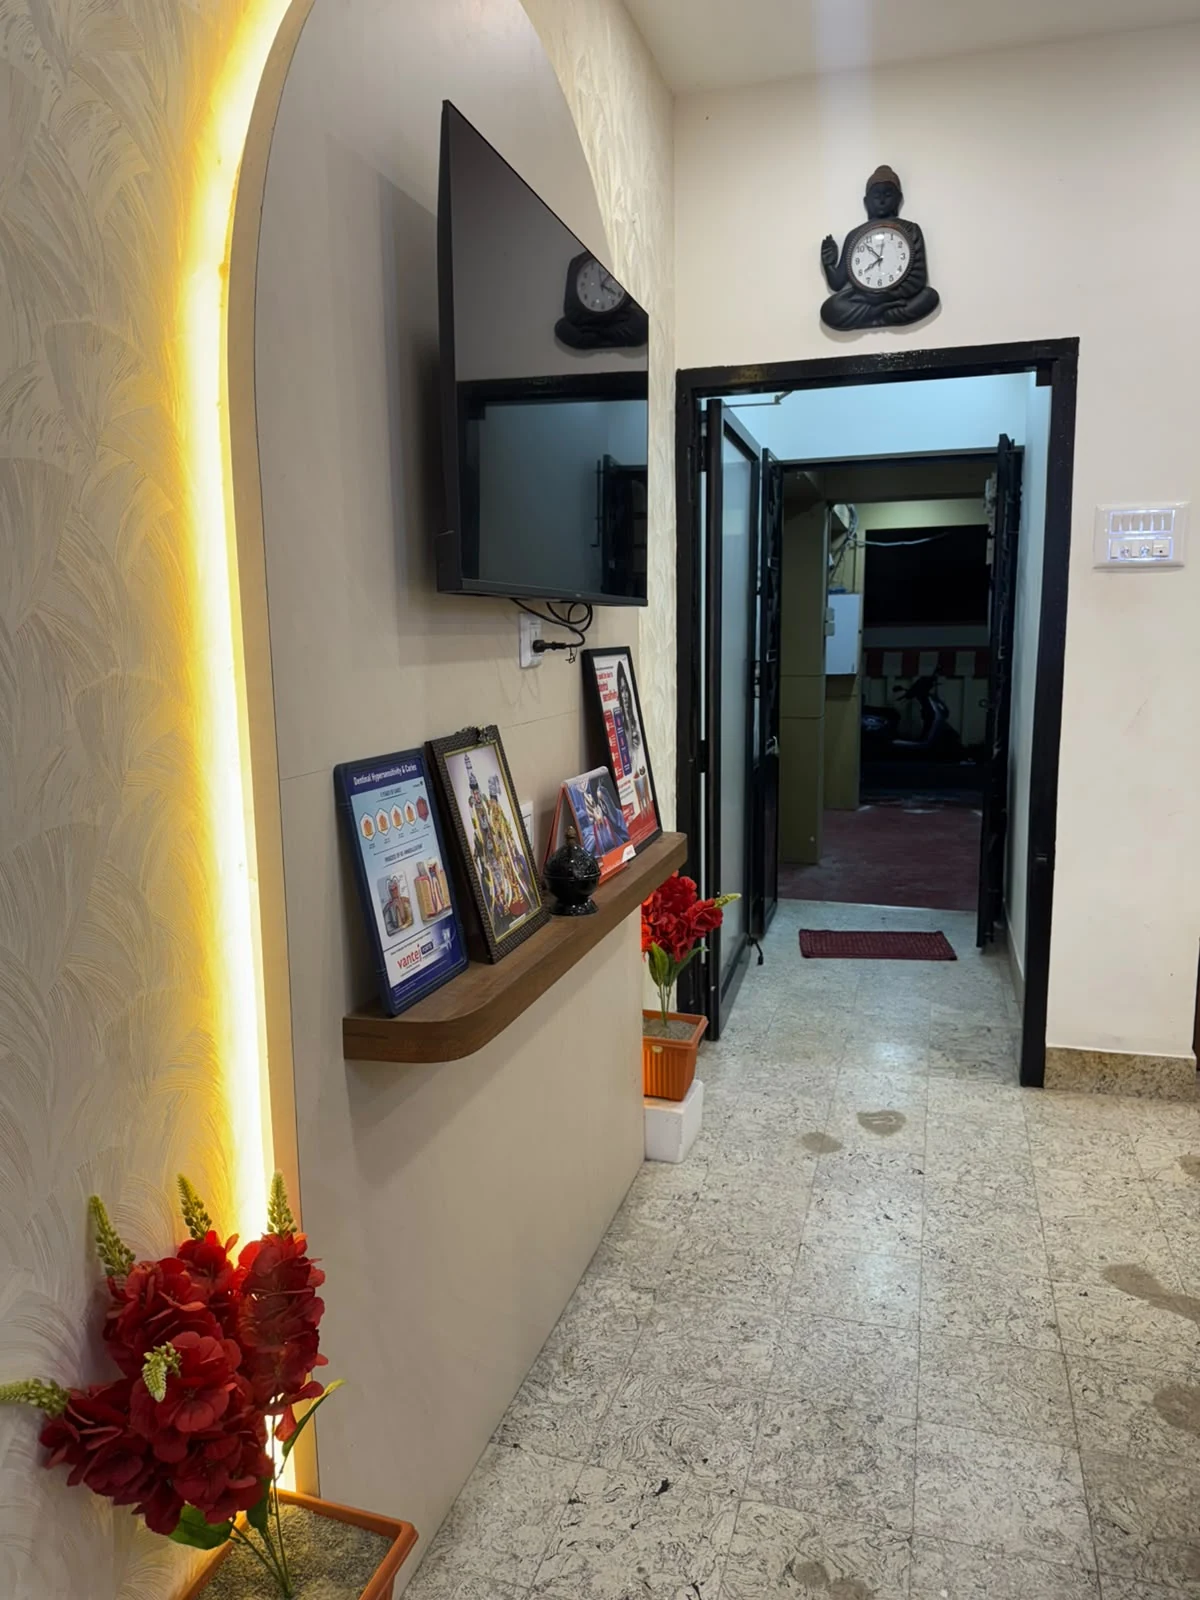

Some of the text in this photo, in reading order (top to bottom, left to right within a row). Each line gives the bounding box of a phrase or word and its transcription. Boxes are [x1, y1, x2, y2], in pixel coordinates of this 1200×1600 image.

[856, 245, 864, 253] 10
[897, 241, 903, 249] 2
[855, 257, 860, 265] 9
[889, 274, 894, 282] 5
[353, 774, 371, 786] Dentinal
[371, 766, 402, 783] Hypersensitivity
[404, 764, 417, 773] Caries
[396, 943, 421, 969] vantej
